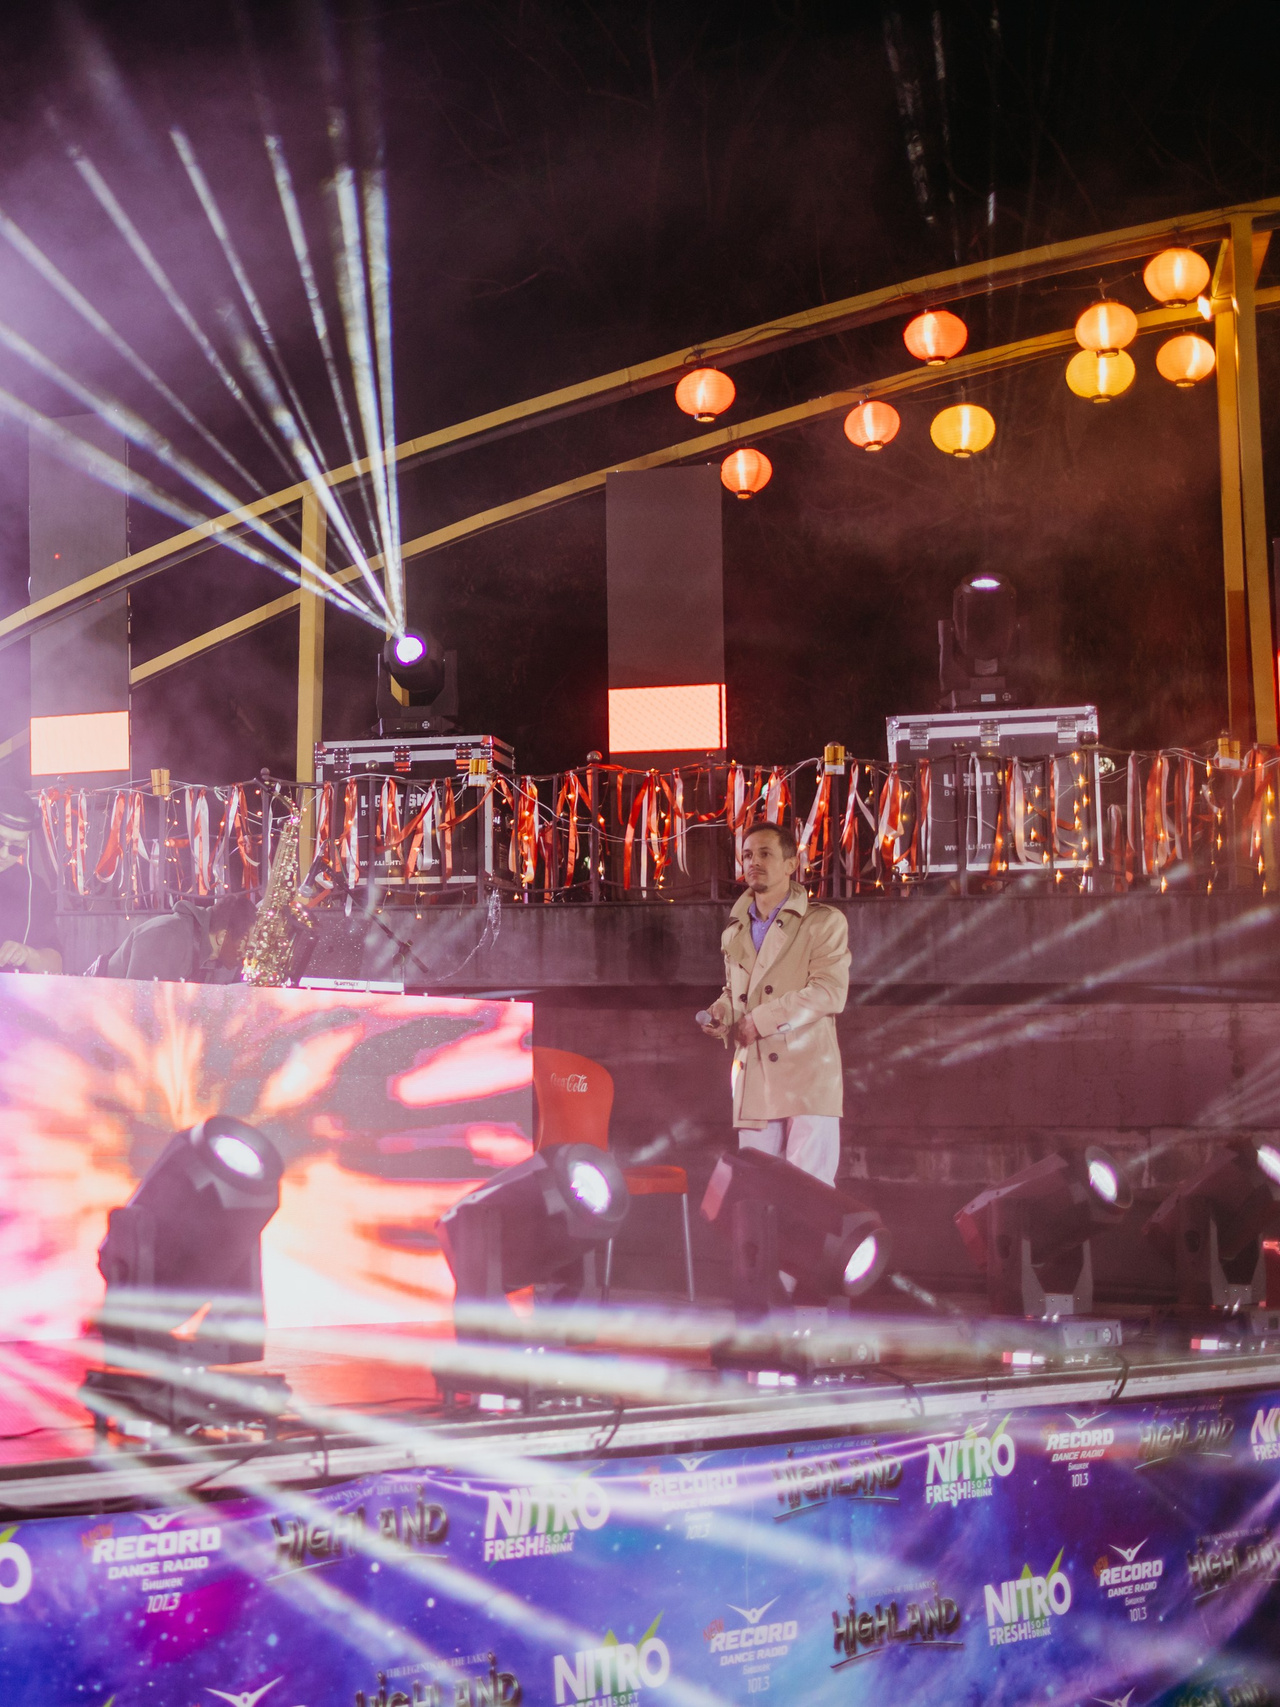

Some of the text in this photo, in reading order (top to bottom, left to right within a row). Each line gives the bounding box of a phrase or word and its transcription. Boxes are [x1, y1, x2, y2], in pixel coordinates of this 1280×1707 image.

[361, 794, 404, 808] LGT
[1046, 1428, 1114, 1451] RECORD
[926, 1433, 1015, 1485] NITRO
[1052, 1449, 1105, 1462] DANCE RADIO
[649, 1469, 738, 1499] RECORD
[926, 1481, 971, 1504] FRESH!
[971, 1479, 992, 1489] SOFT
[971, 1487, 993, 1498] DRINK
[485, 1479, 611, 1540] NITRO
[92, 1527, 221, 1563] RECORD
[484, 1534, 546, 1562] FRESH!
[544, 1541, 574, 1554] DRINK
[545, 1532, 574, 1544] SOFT
[108, 1556, 209, 1580] DANCE RADIO
[1100, 1559, 1163, 1587] RECORD
[142, 1577, 184, 1592] Бишкек
[1108, 1581, 1157, 1598] DANCE RADIO
[147, 1592, 181, 1613] 101.3
[984, 1571, 1071, 1627] NITRO
[832, 1597, 961, 1658] HIGHLAND
[988, 1621, 1032, 1646] FRESH!
[1031, 1618, 1050, 1629] SOFT
[1031, 1627, 1052, 1639] DRINK
[709, 1620, 798, 1653] RECORD
[720, 1645, 788, 1666] DANCE RADIO
[554, 1637, 670, 1705] NITRO
